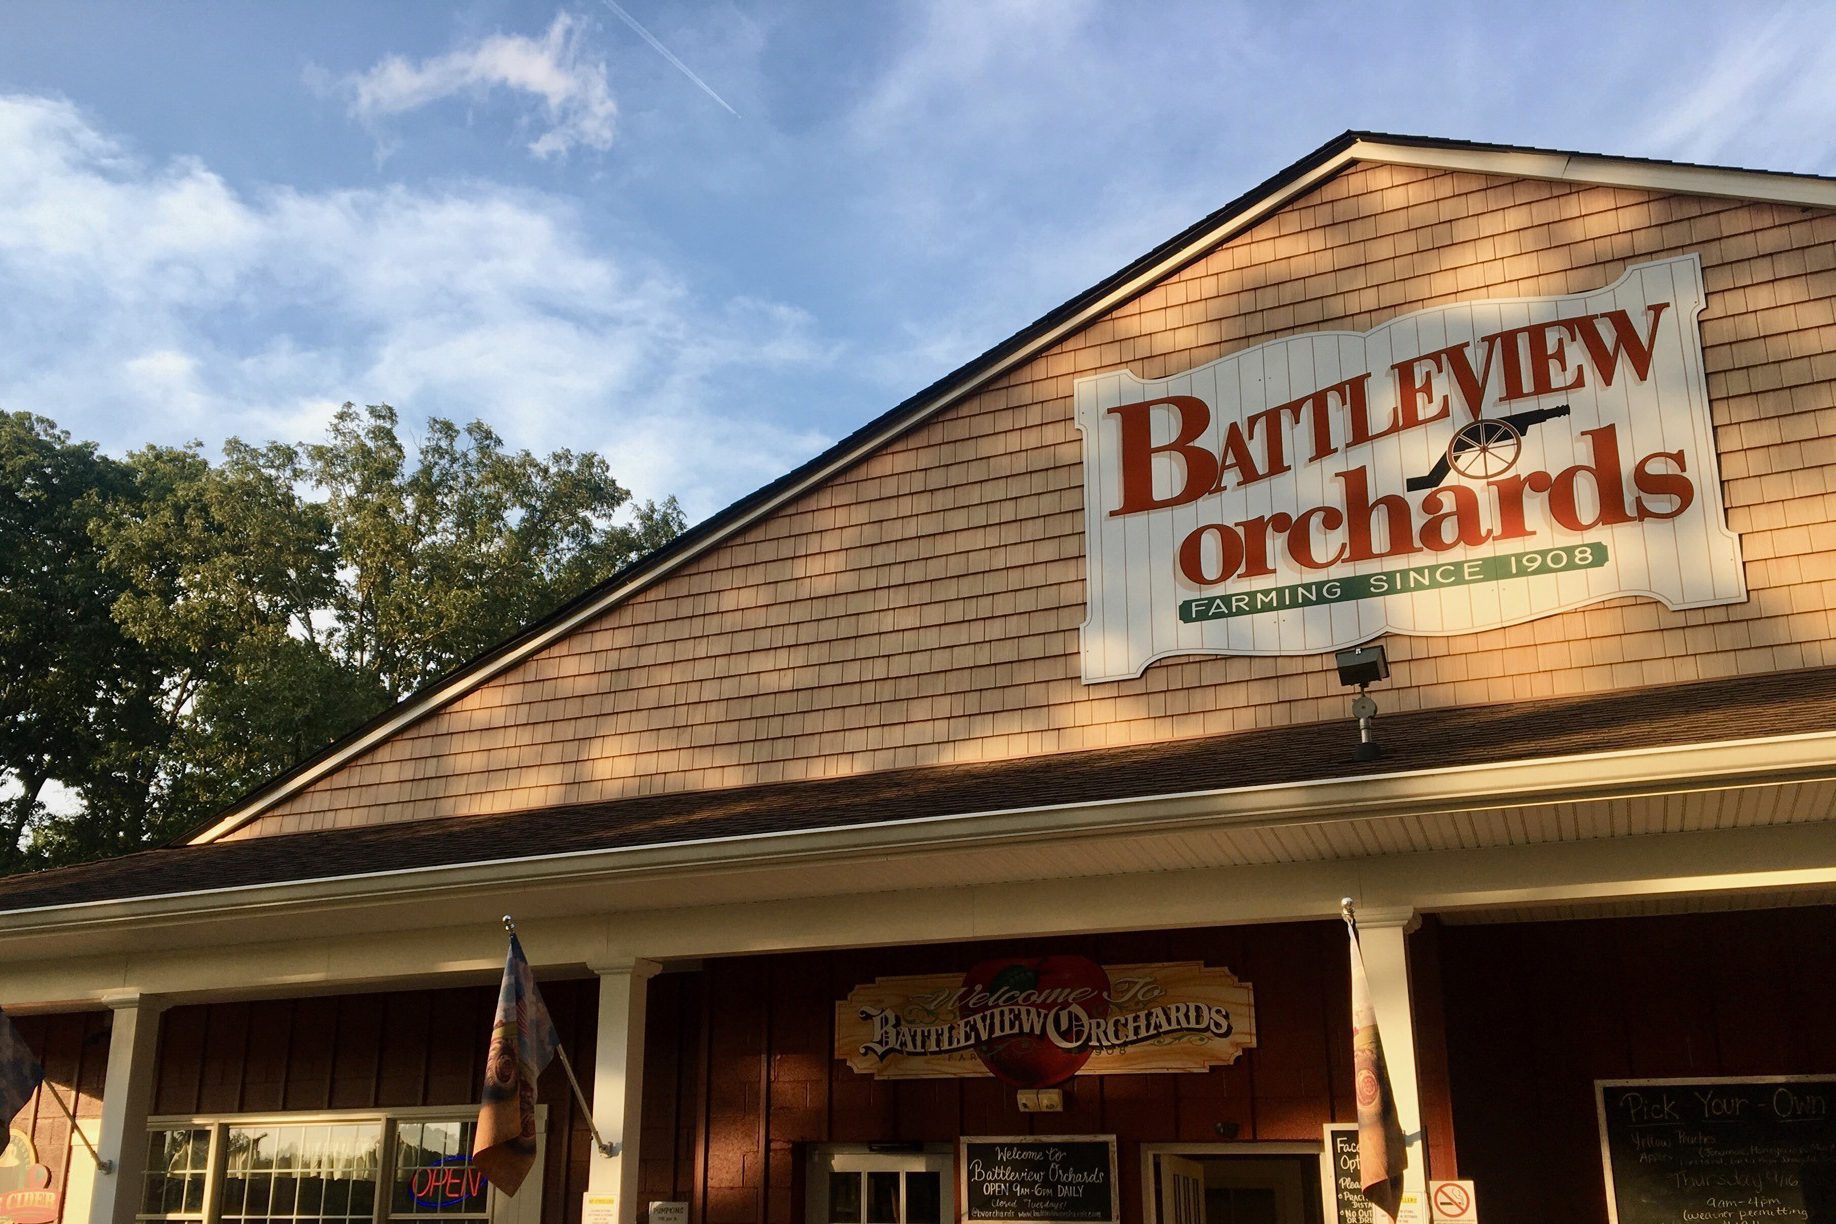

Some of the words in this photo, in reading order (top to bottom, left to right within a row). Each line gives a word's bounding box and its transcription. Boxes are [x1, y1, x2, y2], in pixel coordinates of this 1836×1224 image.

[1107, 301, 1670, 517] BATTLEVIEW
[1179, 423, 1695, 585] orchards
[1190, 579, 1343, 619] FARMING
[1369, 560, 1484, 594] SINCE
[1509, 545, 1594, 576] 1908
[912, 981, 1096, 1011] Welcome
[1104, 976, 1167, 1005] To
[1620, 1092, 1680, 1122] Pick
[1694, 1090, 1750, 1118] Your
[1773, 1087, 1826, 1118] Own
[995, 1146, 1045, 1162] Welcome
[411, 1167, 482, 1198] OPEN
[969, 1159, 1044, 1182] Battleview
[1049, 1162, 1104, 1183] Orchards
[1674, 1170, 1762, 1193] Thursday
[6, 1191, 55, 1210] CIDER
[983, 1183, 1009, 1196] OPEN
[1057, 1184, 1084, 1197] DAILY
